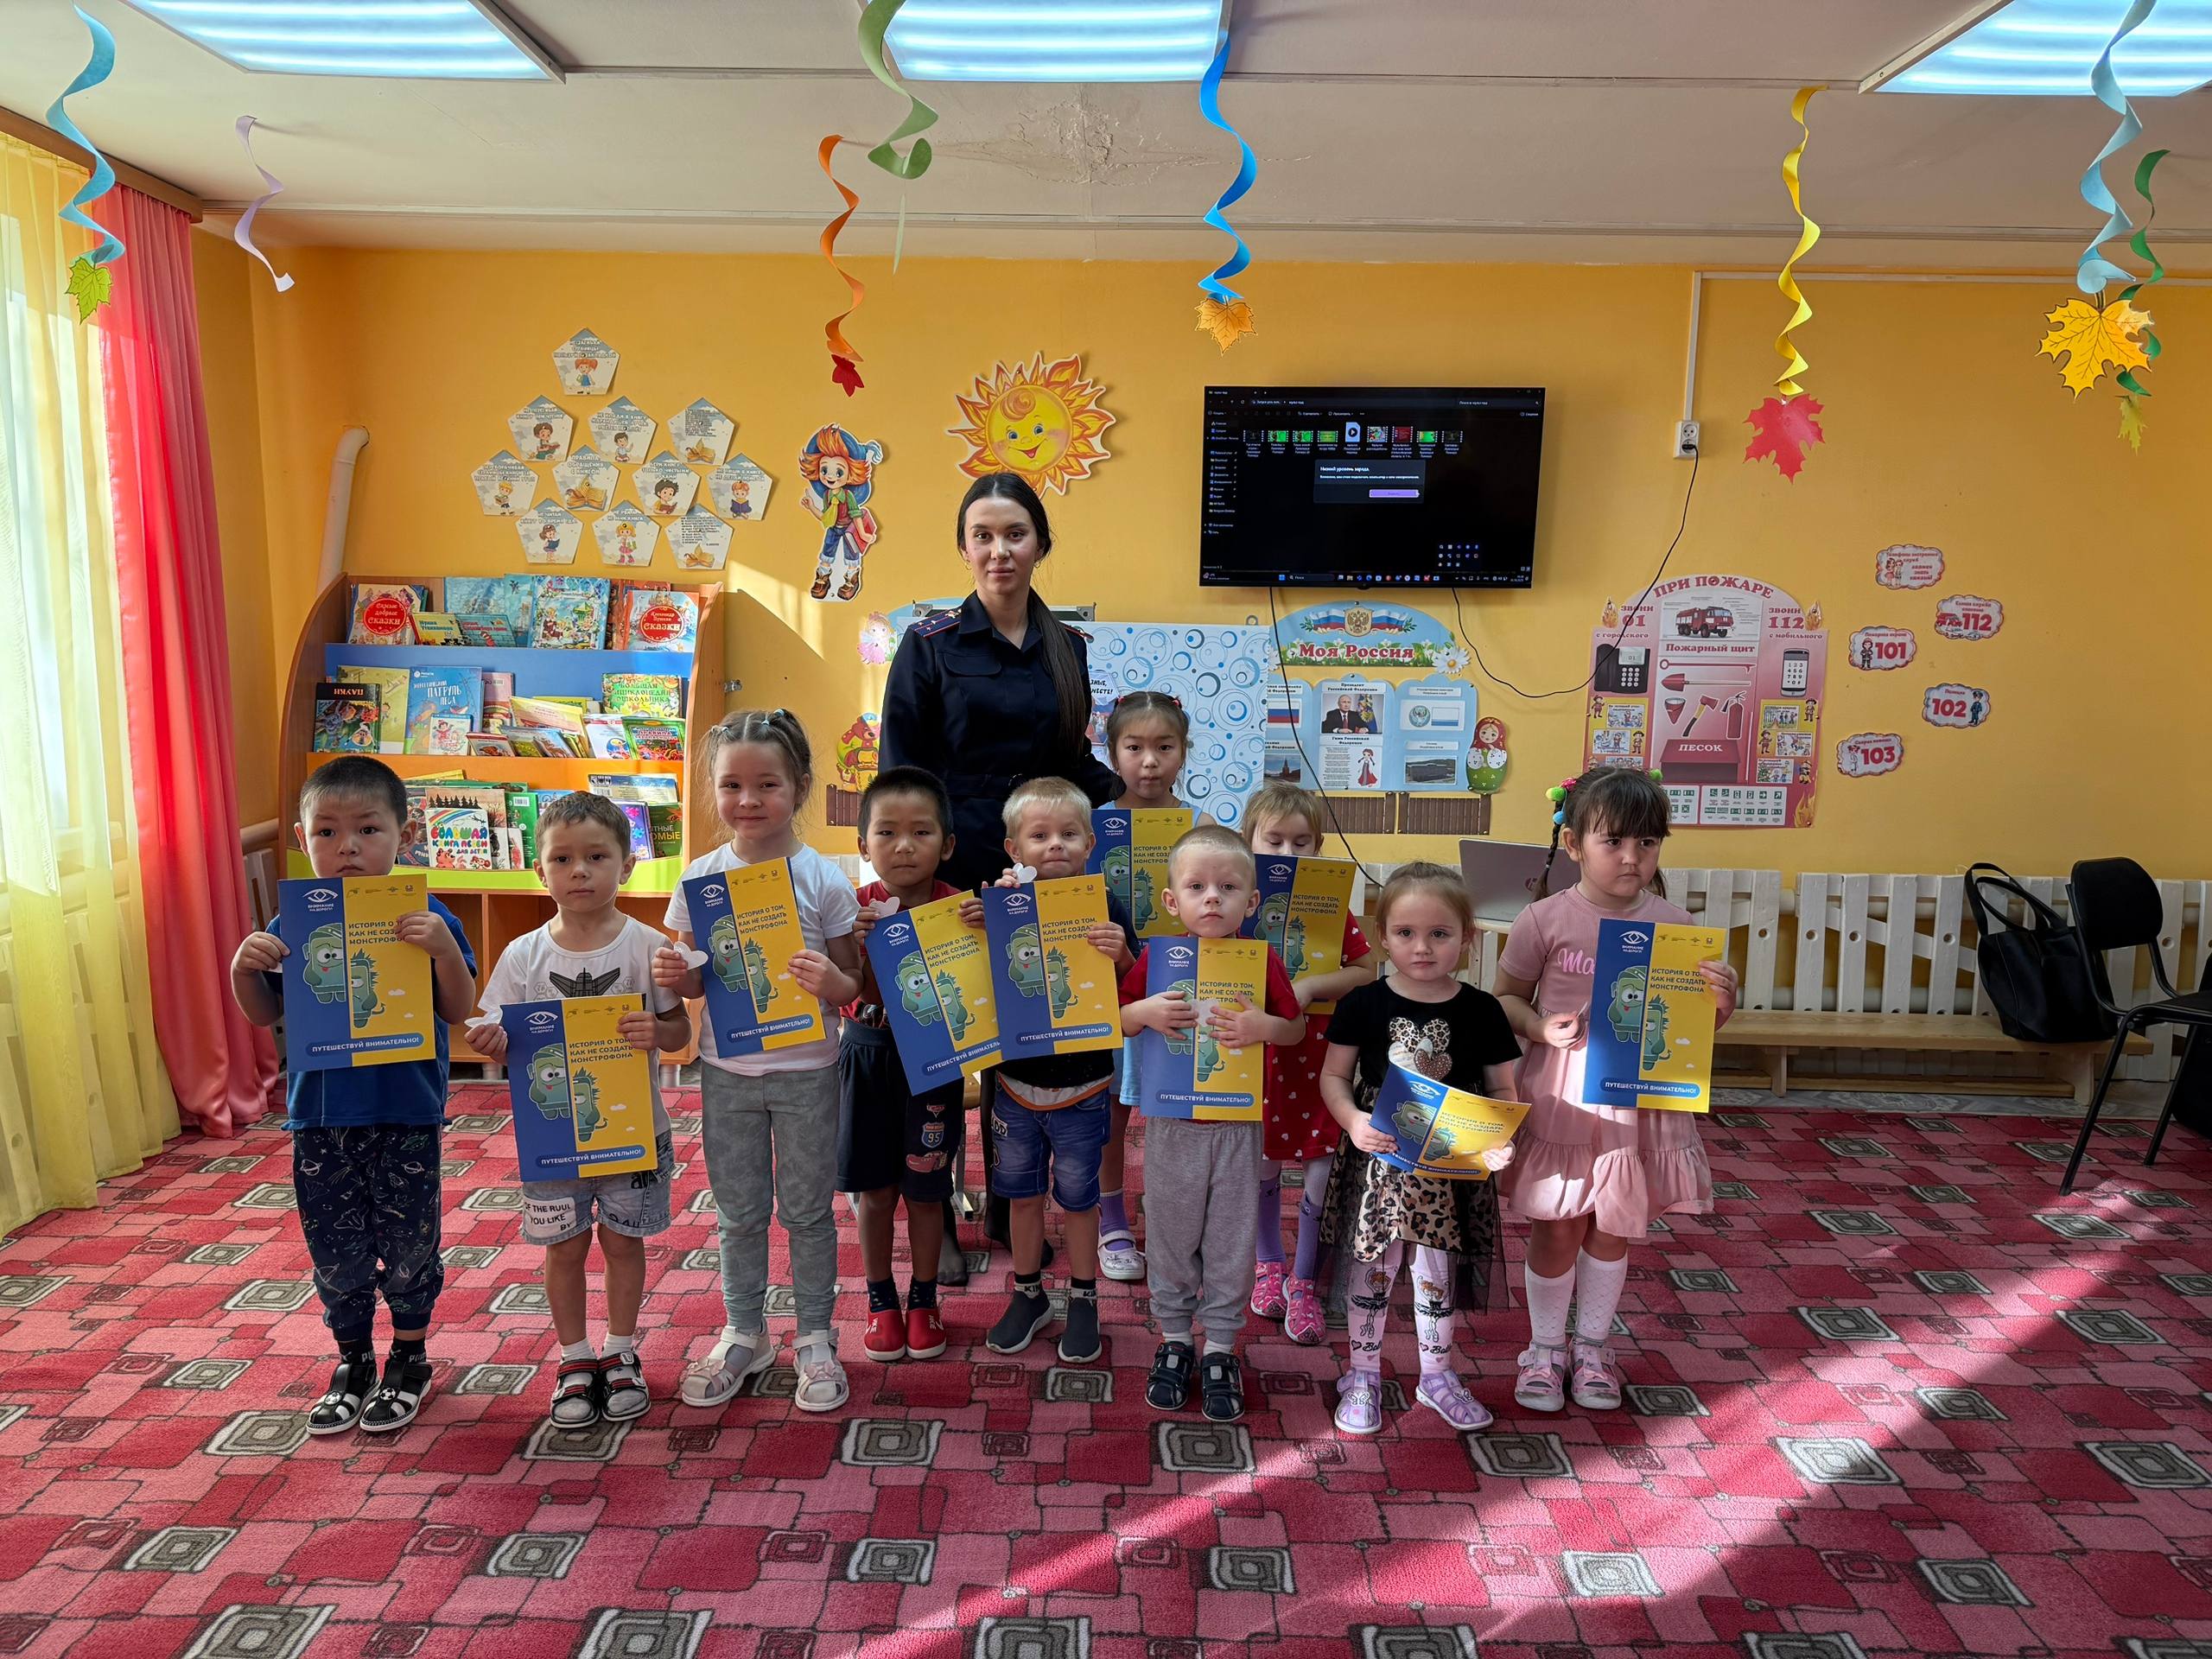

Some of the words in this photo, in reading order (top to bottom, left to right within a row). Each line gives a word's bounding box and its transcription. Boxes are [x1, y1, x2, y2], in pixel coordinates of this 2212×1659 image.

[1653, 577, 1690, 598] ПРИ
[1695, 575, 1774, 599] ПОЖАРЕ
[1622, 615, 1645, 627] 01
[1768, 617, 1804, 629] 112
[1961, 613, 1992, 632] 112
[1299, 644, 1339, 658] Моя
[1345, 645, 1414, 658] Россия
[1666, 643, 1728, 654] Пожарный
[1875, 642, 1906, 659] 101
[427, 684, 461, 698] ПАТРУЛЬ
[1932, 698, 1967, 718] 102
[1861, 747, 1896, 765] 103
[430, 826, 488, 840] БОЛЬШАЯ
[652, 831, 681, 840] ОМЫЕ
[432, 840, 460, 849] КНИГА
[461, 840, 488, 849] ПЕСЕН
[737, 909, 764, 919] ИСТОРИЯ
[771, 904, 786, 912] ТОМ,
[349, 921, 385, 930] ИСТОРИЯ
[738, 918, 752, 926] КАК
[760, 912, 787, 922] СОЗДАТЬ
[1042, 919, 1073, 929] ИСТОРИЯ
[740, 919, 788, 935] МОНСТРОФОНА
[925, 940, 954, 955] ИСТОРИЯ
[961, 933, 976, 943] ТОМ,
[1044, 933, 1088, 943] МОНСТРОФО
[927, 952, 941, 961] КАК
[941, 949, 950, 957] НЕ
[950, 940, 980, 954] СОЗДАТЬ
[929, 947, 980, 969] МОНСТРОФОНА
[1651, 968, 1683, 976] ИСТОРИЯ
[1650, 983, 1705, 993] МОНСТРОФОНА
[731, 1026, 769, 1039] ПУТЕШЕСТВУЙ
[769, 1018, 810, 1031] ВНИМАТЕЛЬНО!
[1020, 1031, 1063, 1041] ПУТЕШЕСТВУЙ
[1065, 1027, 1109, 1037] ВНИМАТЕЛЬНО!
[312, 1040, 364, 1052] ПУТЕШЕСТВУЙ
[365, 1037, 419, 1047] ВНИМАТЕЛЬНО!
[569, 1040, 605, 1049] ИСТОРИЯ
[599, 1046, 633, 1054] СОЗДАТЬ
[570, 1052, 633, 1064] МОНСТРОФОНА
[926, 1052, 968, 1073] ПУТЕШЕСТВУЙ
[968, 1040, 1001, 1058] ВНИМАТЕЛЬ
[1605, 1082, 1649, 1090] ПУТЕШЕСТВУЙ
[1649, 1085, 1697, 1094] ВНИМАТЕЛЬНО!
[1160, 1092, 1205, 1103] ПУТЕШЕСТВУЙ
[928, 1133, 941, 1143] 95
[541, 1154, 589, 1165] ПУТЕШЕСТВУЙ
[591, 1149, 641, 1160] ВНИМАТЕЛЬНО!
[1392, 1153, 1427, 1171] ТЕШЕСТВУЙ
[533, 1205, 547, 1213] THE
[531, 1216, 545, 1225] YOU
[548, 1213, 566, 1224] LIKE
[560, 1222, 572, 1230] BY
